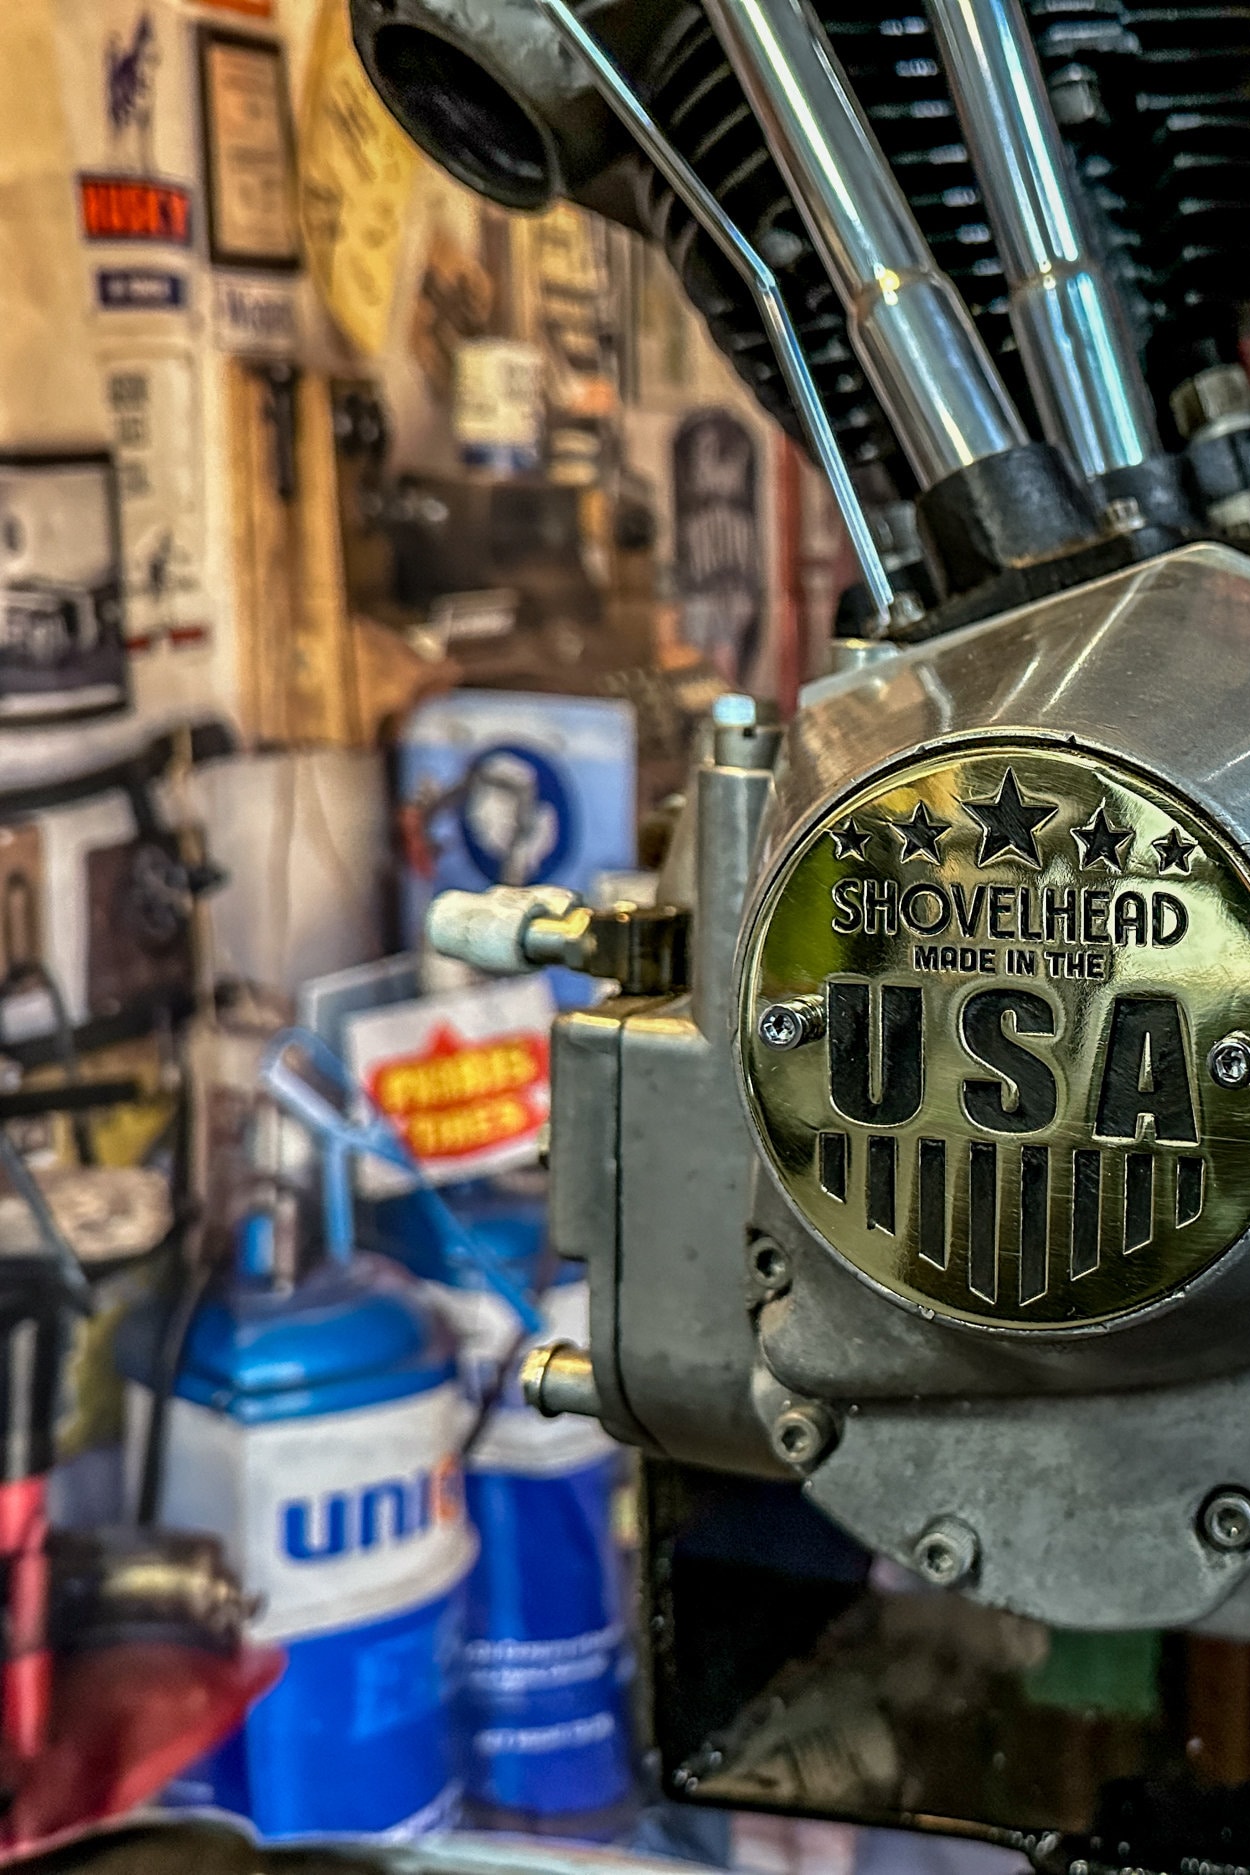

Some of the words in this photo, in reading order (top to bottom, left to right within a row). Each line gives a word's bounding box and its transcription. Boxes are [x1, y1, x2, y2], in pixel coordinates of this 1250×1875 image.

[831, 878, 1190, 949] SHOVELHEAD
[913, 945, 996, 974] MADE
[1005, 949, 1036, 977] IN
[1045, 951, 1106, 980] THE
[827, 979, 1201, 1147] USA
